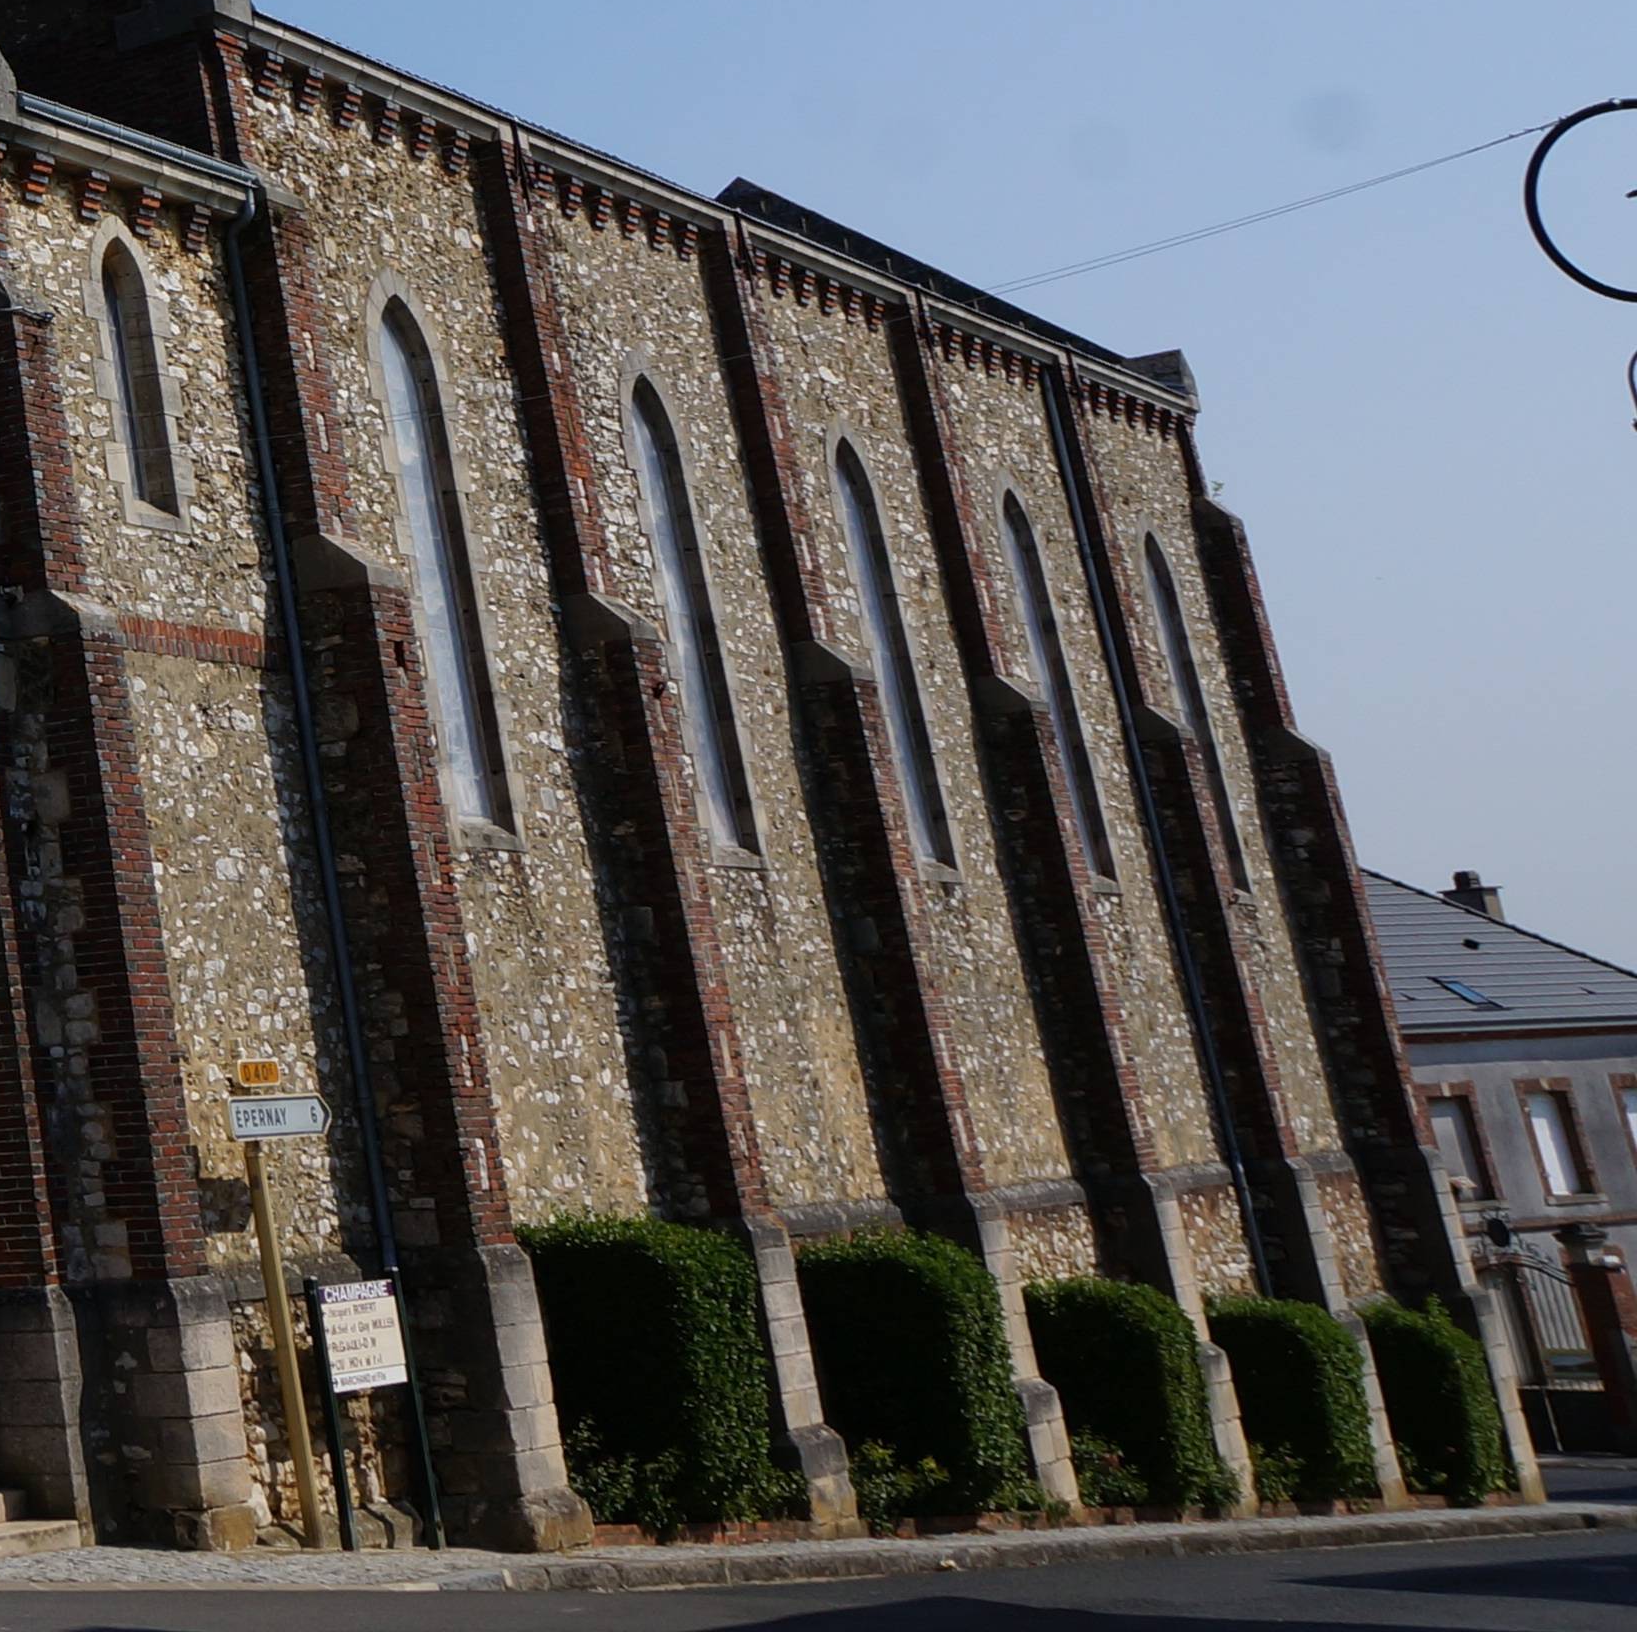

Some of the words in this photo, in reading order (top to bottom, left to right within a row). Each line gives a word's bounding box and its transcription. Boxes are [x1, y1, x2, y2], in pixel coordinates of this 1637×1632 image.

[242, 1064, 251, 1082] D
[235, 1106, 287, 1129] ÉPERNAY
[310, 1106, 318, 1124] 6
[325, 1280, 389, 1303] CHAMPAGNE
